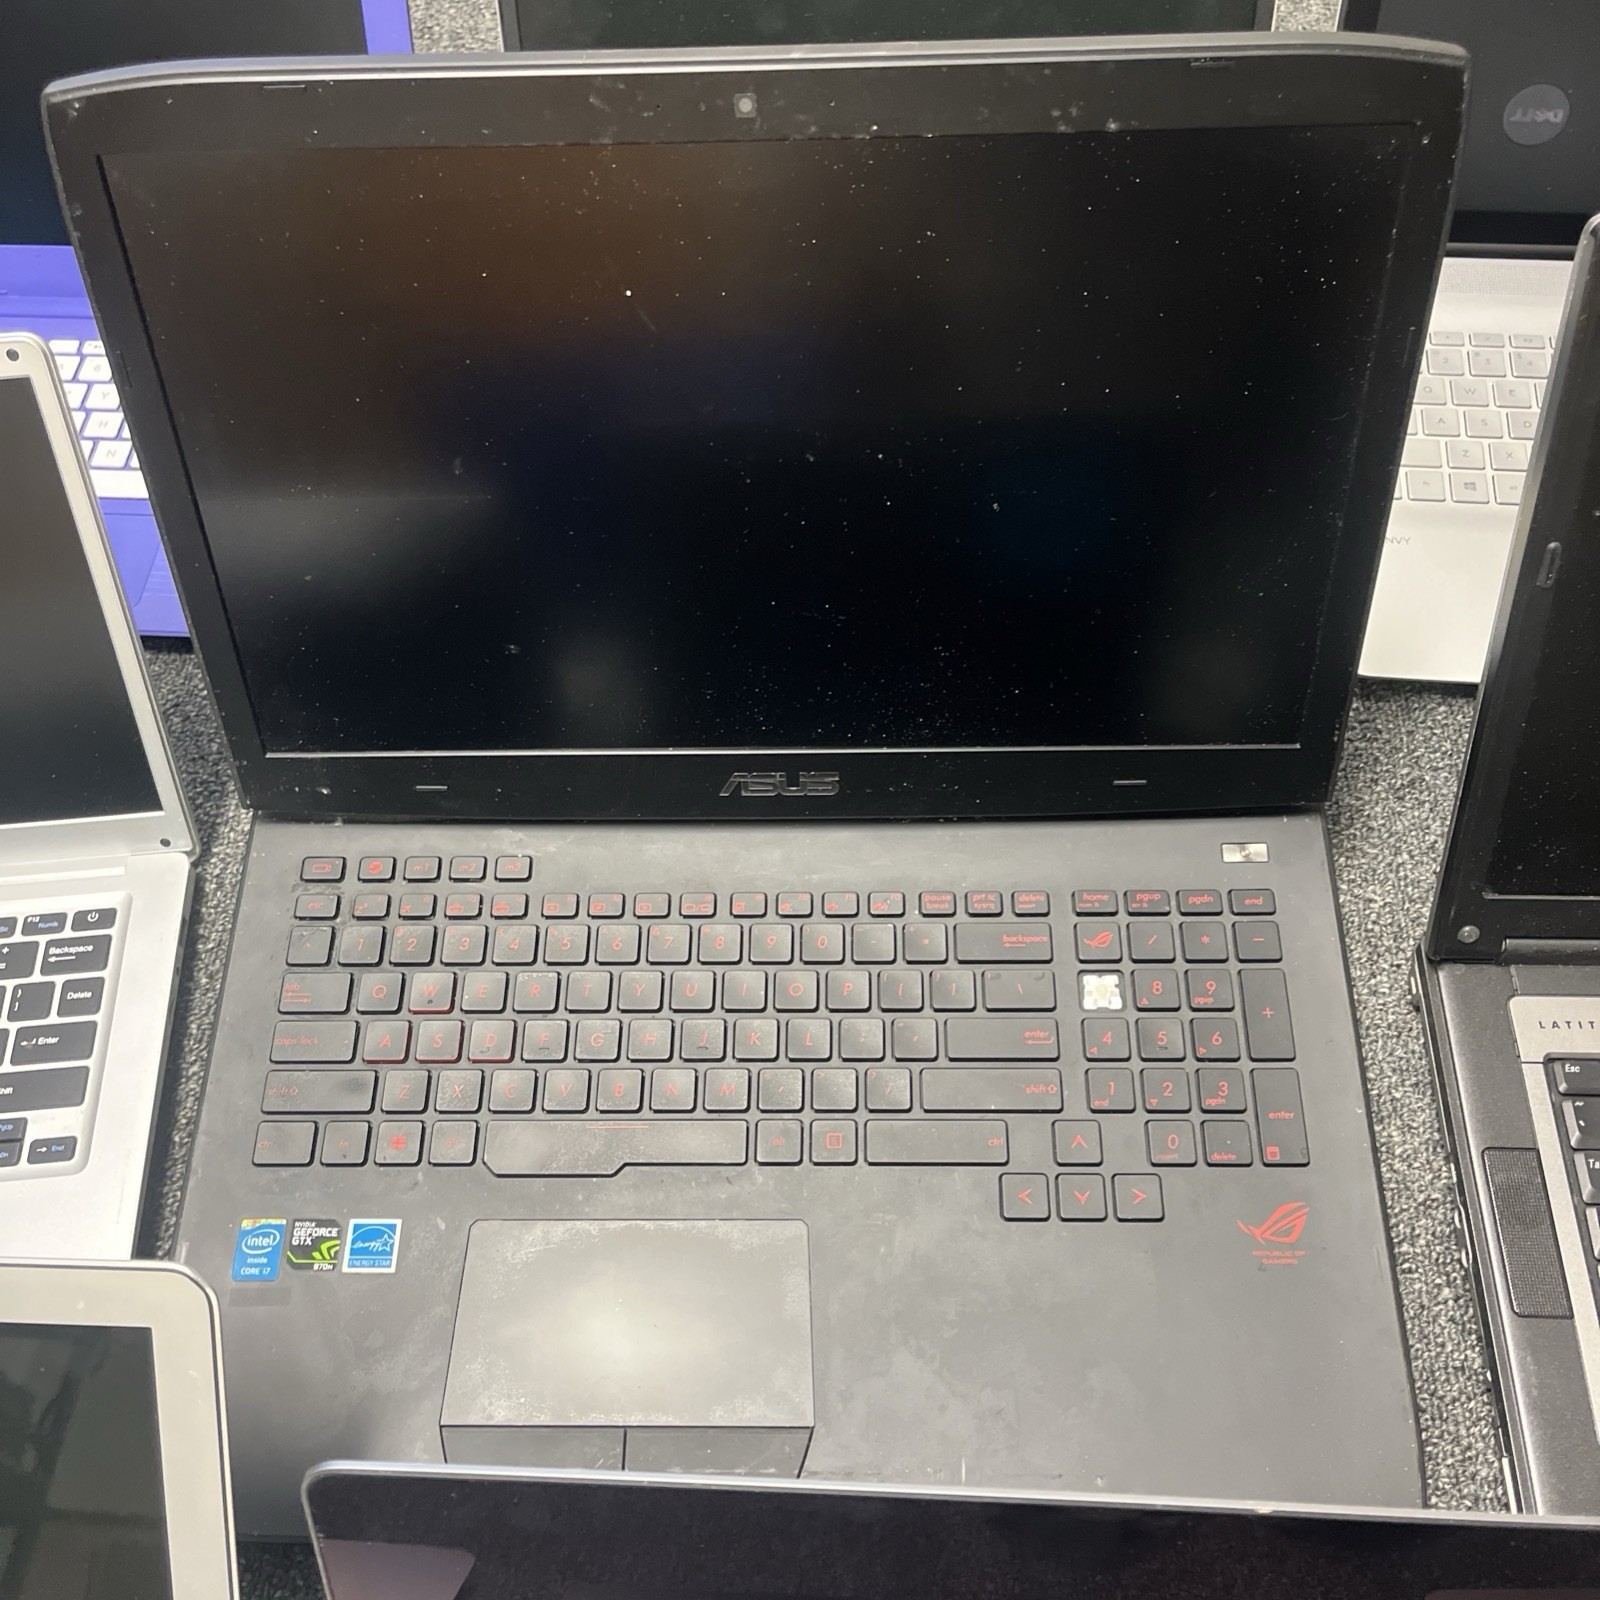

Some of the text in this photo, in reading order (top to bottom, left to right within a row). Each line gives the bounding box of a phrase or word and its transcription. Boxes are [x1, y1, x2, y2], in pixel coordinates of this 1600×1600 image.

[1464, 386, 1476, 395] W
[1437, 417, 1446, 425] A
[1480, 418, 1488, 427] S
[1524, 420, 1532, 429] D
[1462, 450, 1470, 458] Z
[1505, 451, 1514, 460] X
[1385, 536, 1411, 546] NVY
[719, 771, 840, 796] ASUS
[925, 893, 952, 903] pause
[1018, 893, 1045, 902] delete
[1082, 892, 1110, 901] home
[1136, 892, 1162, 903] pgup
[1187, 894, 1214, 906] pgdn
[1244, 896, 1264, 906] end
[926, 901, 950, 910] break
[355, 938, 365, 952] 1
[406, 937, 417, 952] 2
[459, 937, 470, 951] 3
[509, 937, 520, 951] 4
[560, 936, 571, 951] 5
[611, 936, 622, 951] 6
[663, 935, 674, 950] 7
[714, 935, 725, 950] 8
[765, 935, 777, 949] 9
[816, 935, 828, 949] 0
[1002, 934, 1049, 944] backspace
[48, 944, 94, 956] Backspace
[371, 984, 388, 999] Q
[422, 984, 439, 998] W
[477, 984, 489, 998] E
[530, 984, 541, 997] R
[582, 984, 593, 997] T
[635, 983, 646, 997] Y
[685, 983, 698, 997] U
[788, 982, 804, 998] O
[842, 983, 854, 996] P
[1152, 980, 1163, 995] 8
[1205, 980, 1217, 995] 9
[66, 989, 92, 1001] Delete
[1193, 996, 1214, 1006] pgup
[1538, 1020, 1596, 1030] LATIT
[37, 1036, 60, 1046] Enter
[275, 1035, 318, 1047] caps lock
[379, 1034, 392, 1048] A
[432, 1034, 443, 1048] S
[483, 1033, 498, 1048] D
[538, 1033, 549, 1046] F
[590, 1032, 605, 1047] G
[644, 1033, 658, 1046] H
[699, 1032, 709, 1046] J
[749, 1032, 762, 1046] K
[804, 1032, 813, 1046] L
[1023, 1030, 1051, 1039] enter
[1101, 1031, 1113, 1046] 4
[1156, 1031, 1168, 1046] 5
[1211, 1031, 1223, 1046] 6
[1564, 1064, 1581, 1073] Esc
[398, 1084, 411, 1099] Z
[451, 1084, 464, 1098] X
[503, 1083, 518, 1099] C
[560, 1083, 572, 1098] V
[613, 1083, 624, 1097] B
[664, 1083, 680, 1097] N
[719, 1083, 735, 1096] M
[1024, 1084, 1047, 1094] shift
[1107, 1081, 1115, 1096] 1
[1162, 1081, 1174, 1096] 2
[1217, 1081, 1229, 1097] 3
[1092, 1097, 1110, 1108] end
[1204, 1097, 1227, 1107] pgdn
[1268, 1109, 1295, 1120] enter
[771, 1136, 786, 1147] alt
[987, 1136, 1004, 1147] ctrl
[1167, 1134, 1179, 1150] 0
[1210, 1151, 1238, 1161] delete
[293, 1228, 338, 1237] GEFORCE
[246, 1234, 274, 1247] intel
[291, 1236, 313, 1246] GTX
[246, 1255, 268, 1264] inside
[348, 1258, 391, 1267] ENERGY STAR
[240, 1266, 271, 1276] CORE i7
